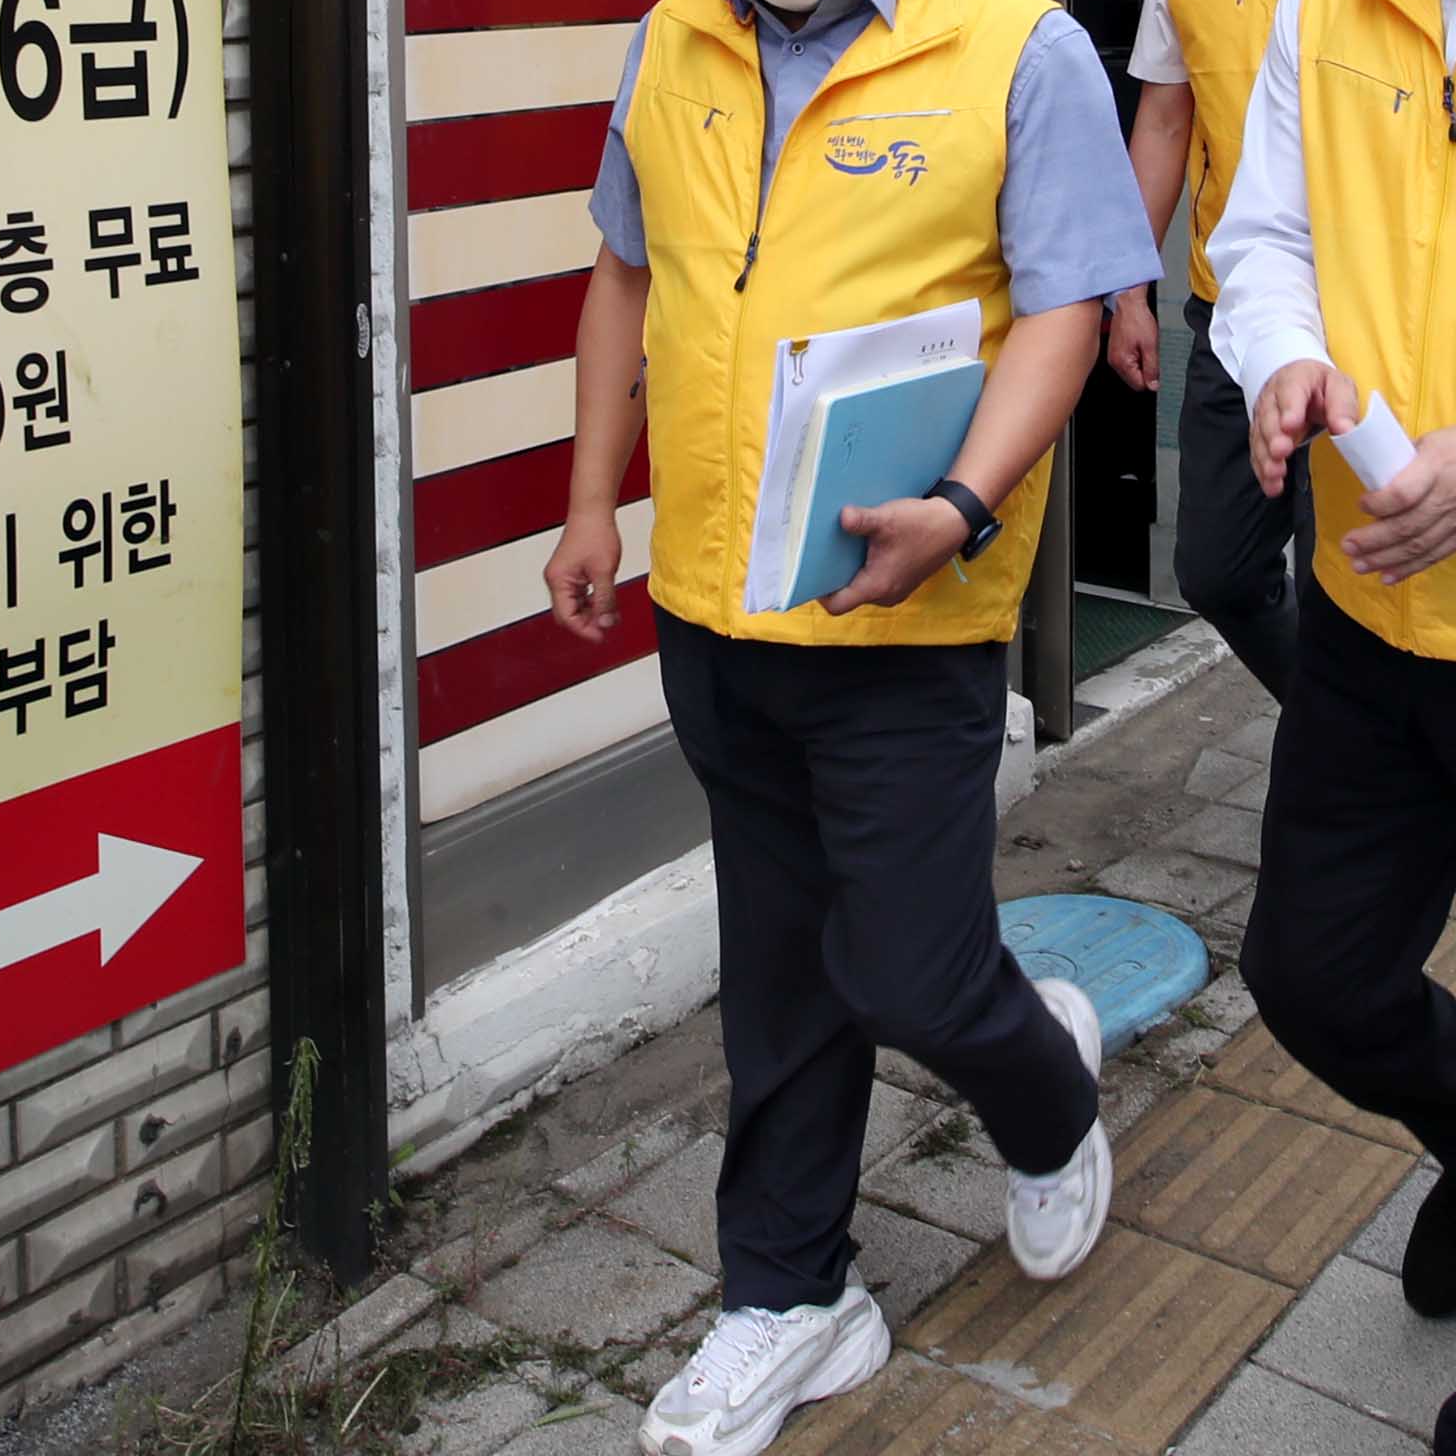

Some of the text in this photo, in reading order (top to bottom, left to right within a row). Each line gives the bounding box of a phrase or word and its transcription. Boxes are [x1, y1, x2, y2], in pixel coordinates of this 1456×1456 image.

[887, 140, 928, 186] 동구
[83, 200, 200, 300] 무료
[57, 476, 179, 590] 위한
